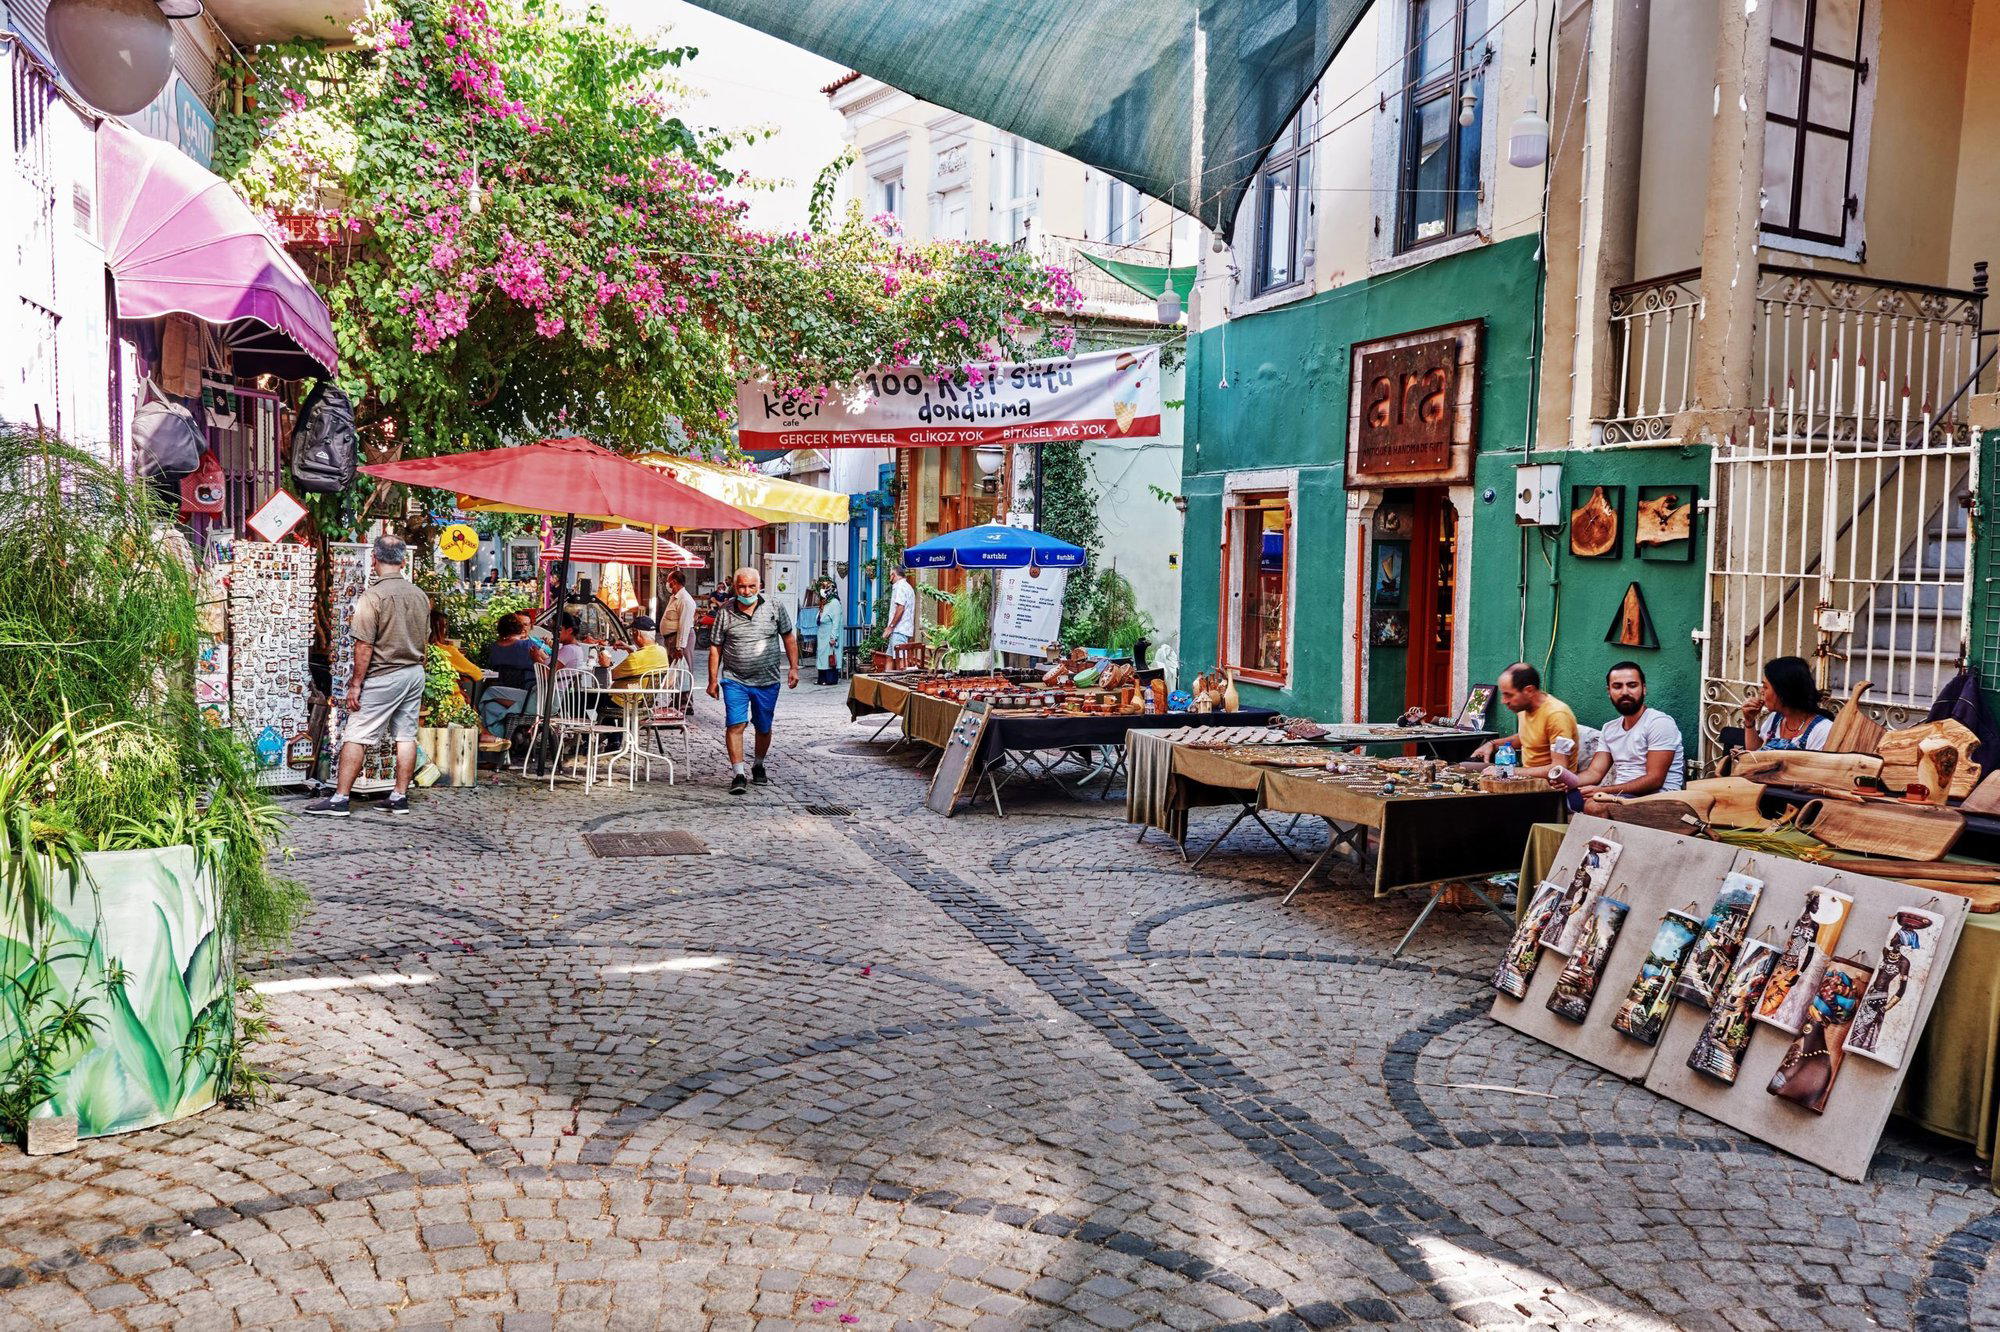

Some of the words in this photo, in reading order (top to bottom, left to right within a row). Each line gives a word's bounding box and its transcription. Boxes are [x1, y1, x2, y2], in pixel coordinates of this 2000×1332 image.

[865, 373, 923, 398] 100
[1367, 367, 1446, 429] ara
[763, 393, 823, 420] keçi
[918, 392, 1031, 424] dondurma
[779, 434, 829, 446] GERÇEK
[832, 433, 896, 445] MEYVELER
[909, 430, 955, 443] GLİKOZ
[958, 430, 984, 441] YOK
[1003, 426, 1053, 439] BİTKİSEL
[1054, 424, 1079, 437] YAĞ
[1082, 424, 1107, 435] YOK
[1392, 442, 1428, 455] HANDMADE
[1429, 441, 1444, 451] GIFT
